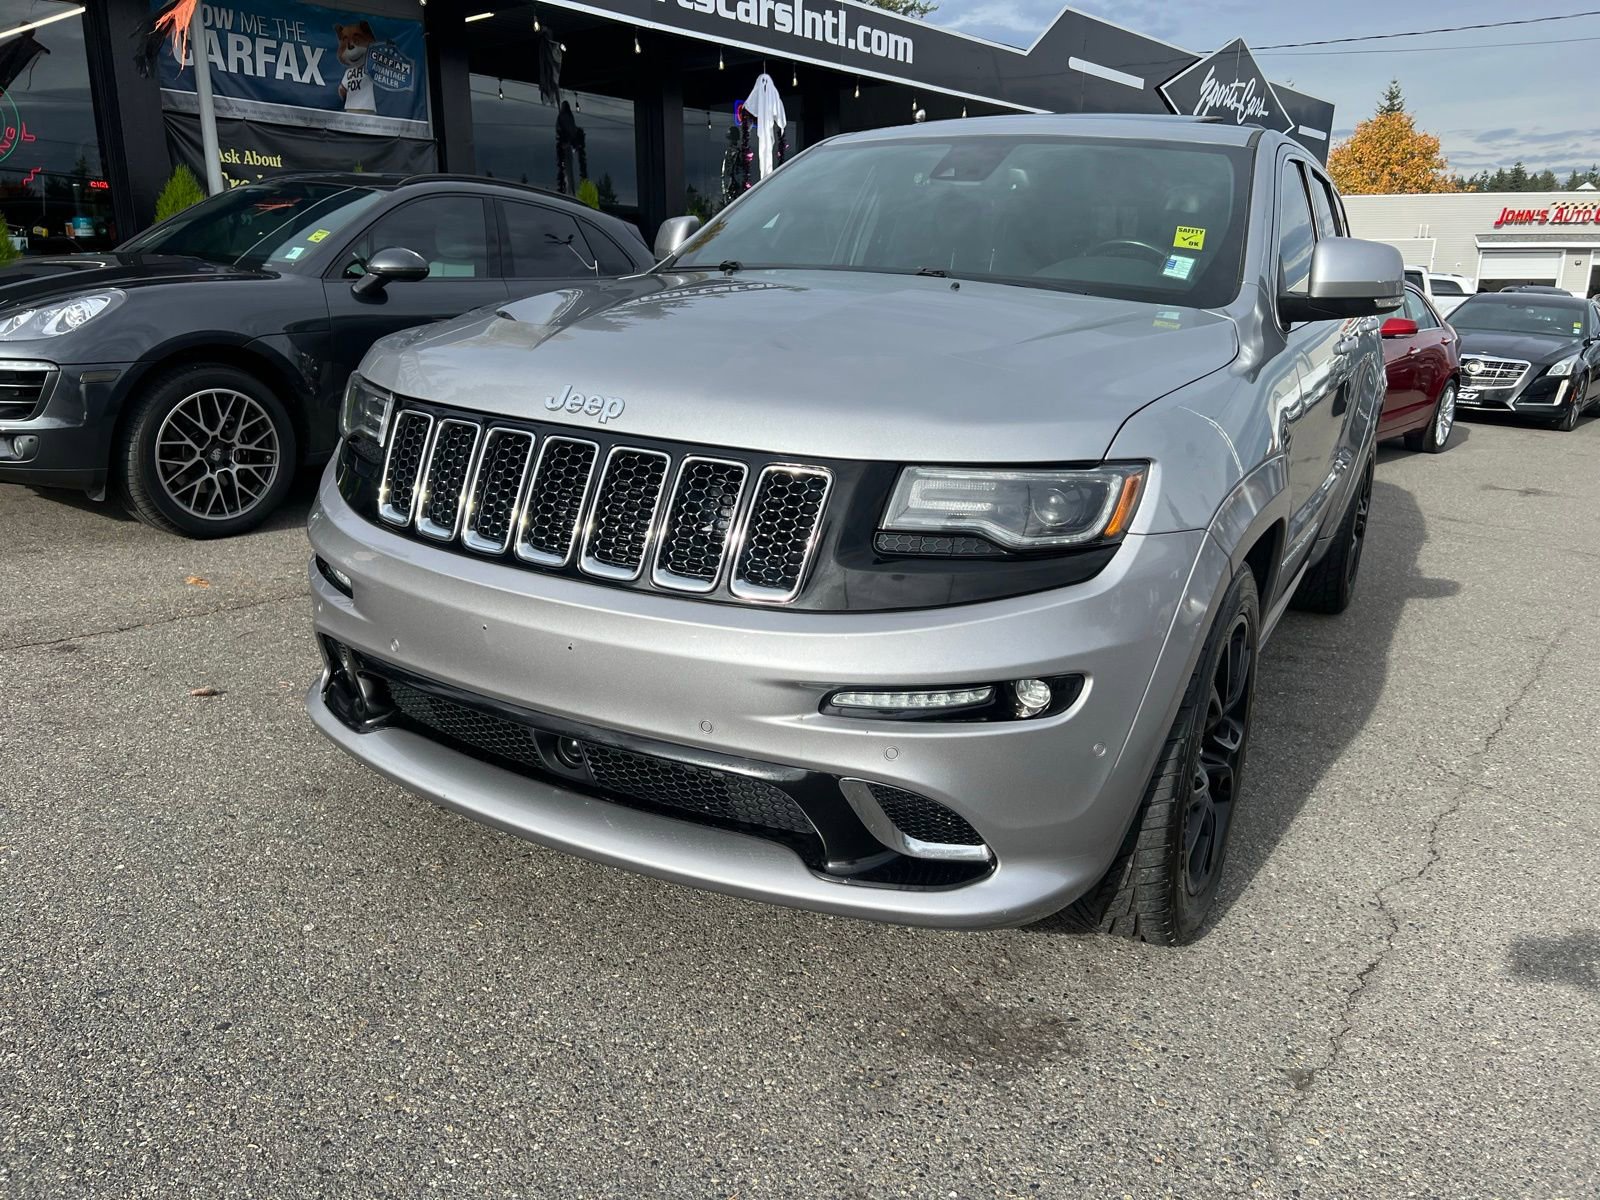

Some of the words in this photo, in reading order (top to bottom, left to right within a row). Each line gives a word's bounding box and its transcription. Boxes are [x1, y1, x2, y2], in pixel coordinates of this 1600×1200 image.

[240, 12, 269, 37] ME
[272, 18, 307, 43] THE
[172, 27, 326, 86] CARFAX
[372, 63, 406, 82] ADVANTAGE
[374, 73, 399, 88] DEALER
[347, 80, 361, 91] FOX
[244, 150, 282, 167] About
[1494, 207, 1549, 228] JOHN'S
[1551, 207, 1593, 223] AUTO
[1178, 227, 1204, 235] SAFETY
[544, 384, 626, 424] Jeep
